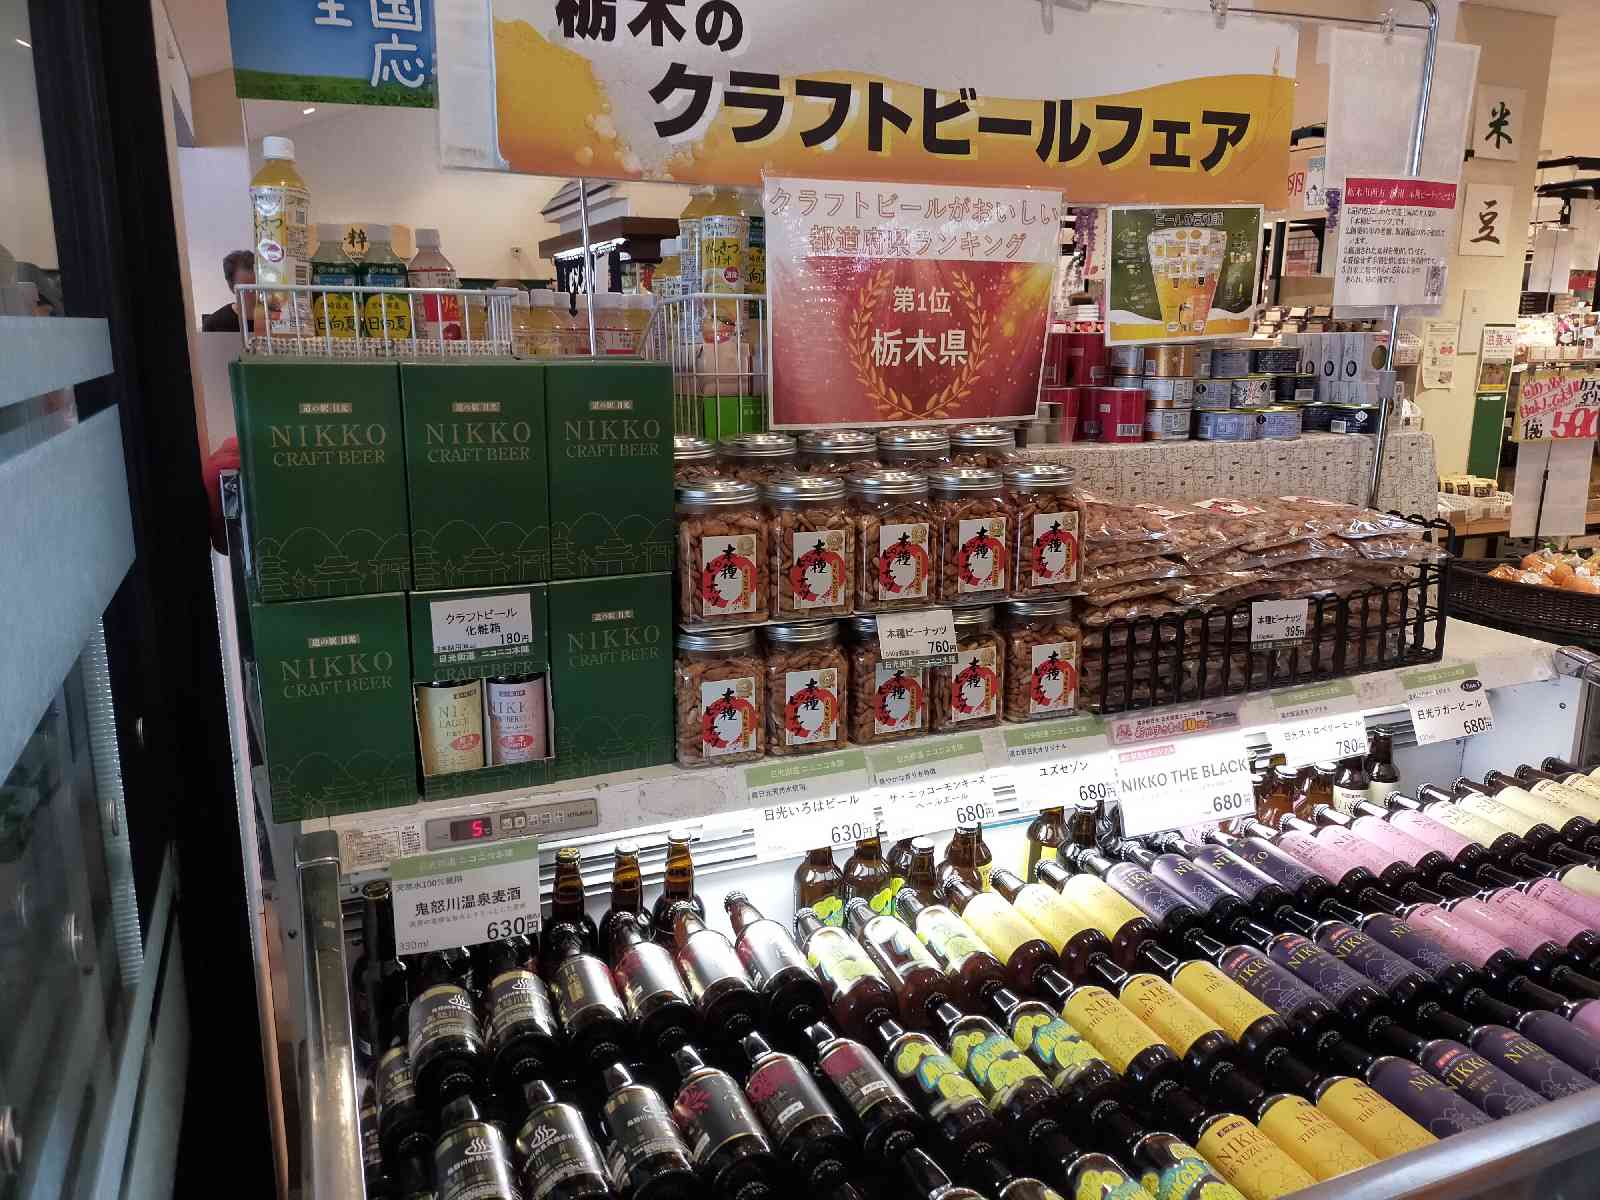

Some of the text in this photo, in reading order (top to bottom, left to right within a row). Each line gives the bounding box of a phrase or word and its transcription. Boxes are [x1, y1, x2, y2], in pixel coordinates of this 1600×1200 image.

[648, 63, 1250, 172] クラフトビールフェア
[1485, 101, 1512, 149] 米
[769, 187, 1060, 225] クラフトビールがおいしい
[1470, 200, 1500, 244] 豆
[809, 224, 1027, 259] 都道府県ランキング
[893, 287, 952, 313] 第1位
[871, 328, 968, 368] 栃木県
[271, 423, 386, 448] NIKKO
[425, 421, 531, 444] NIKKO
[564, 419, 661, 441] NIKKO
[273, 449, 385, 467] CRAFT BEER
[426, 447, 529, 463] CRAFT BEER
[566, 442, 659, 458] CRAFT BEER
[446, 607, 518, 625] クラフトビール
[465, 623, 501, 637] 化粧箱
[500, 633, 529, 646] 180円
[567, 624, 660, 653] NIKKO
[887, 626, 947, 639] 本種ピーナッツ
[1284, 625, 1305, 637] 395円
[568, 646, 659, 668] CRAFT BEER
[928, 640, 957, 654] 760円
[280, 650, 393, 680] NIKKO
[284, 675, 392, 699] CRAFT BEER
[1417, 699, 1482, 720] 日光ラガービール
[1463, 717, 1493, 735] 680円
[1336, 738, 1366, 756] 780円
[1040, 760, 1088, 776] ユズセゾン
[1121, 759, 1248, 793] NIKKO THE BLACK
[1079, 782, 1118, 801] 680円
[764, 795, 860, 821] 日光いろはビール
[956, 803, 995, 824] 680円
[831, 822, 873, 843] 630円
[415, 886, 521, 917] 鬼怒川温泉麦酒
[487, 916, 539, 941] 630円
